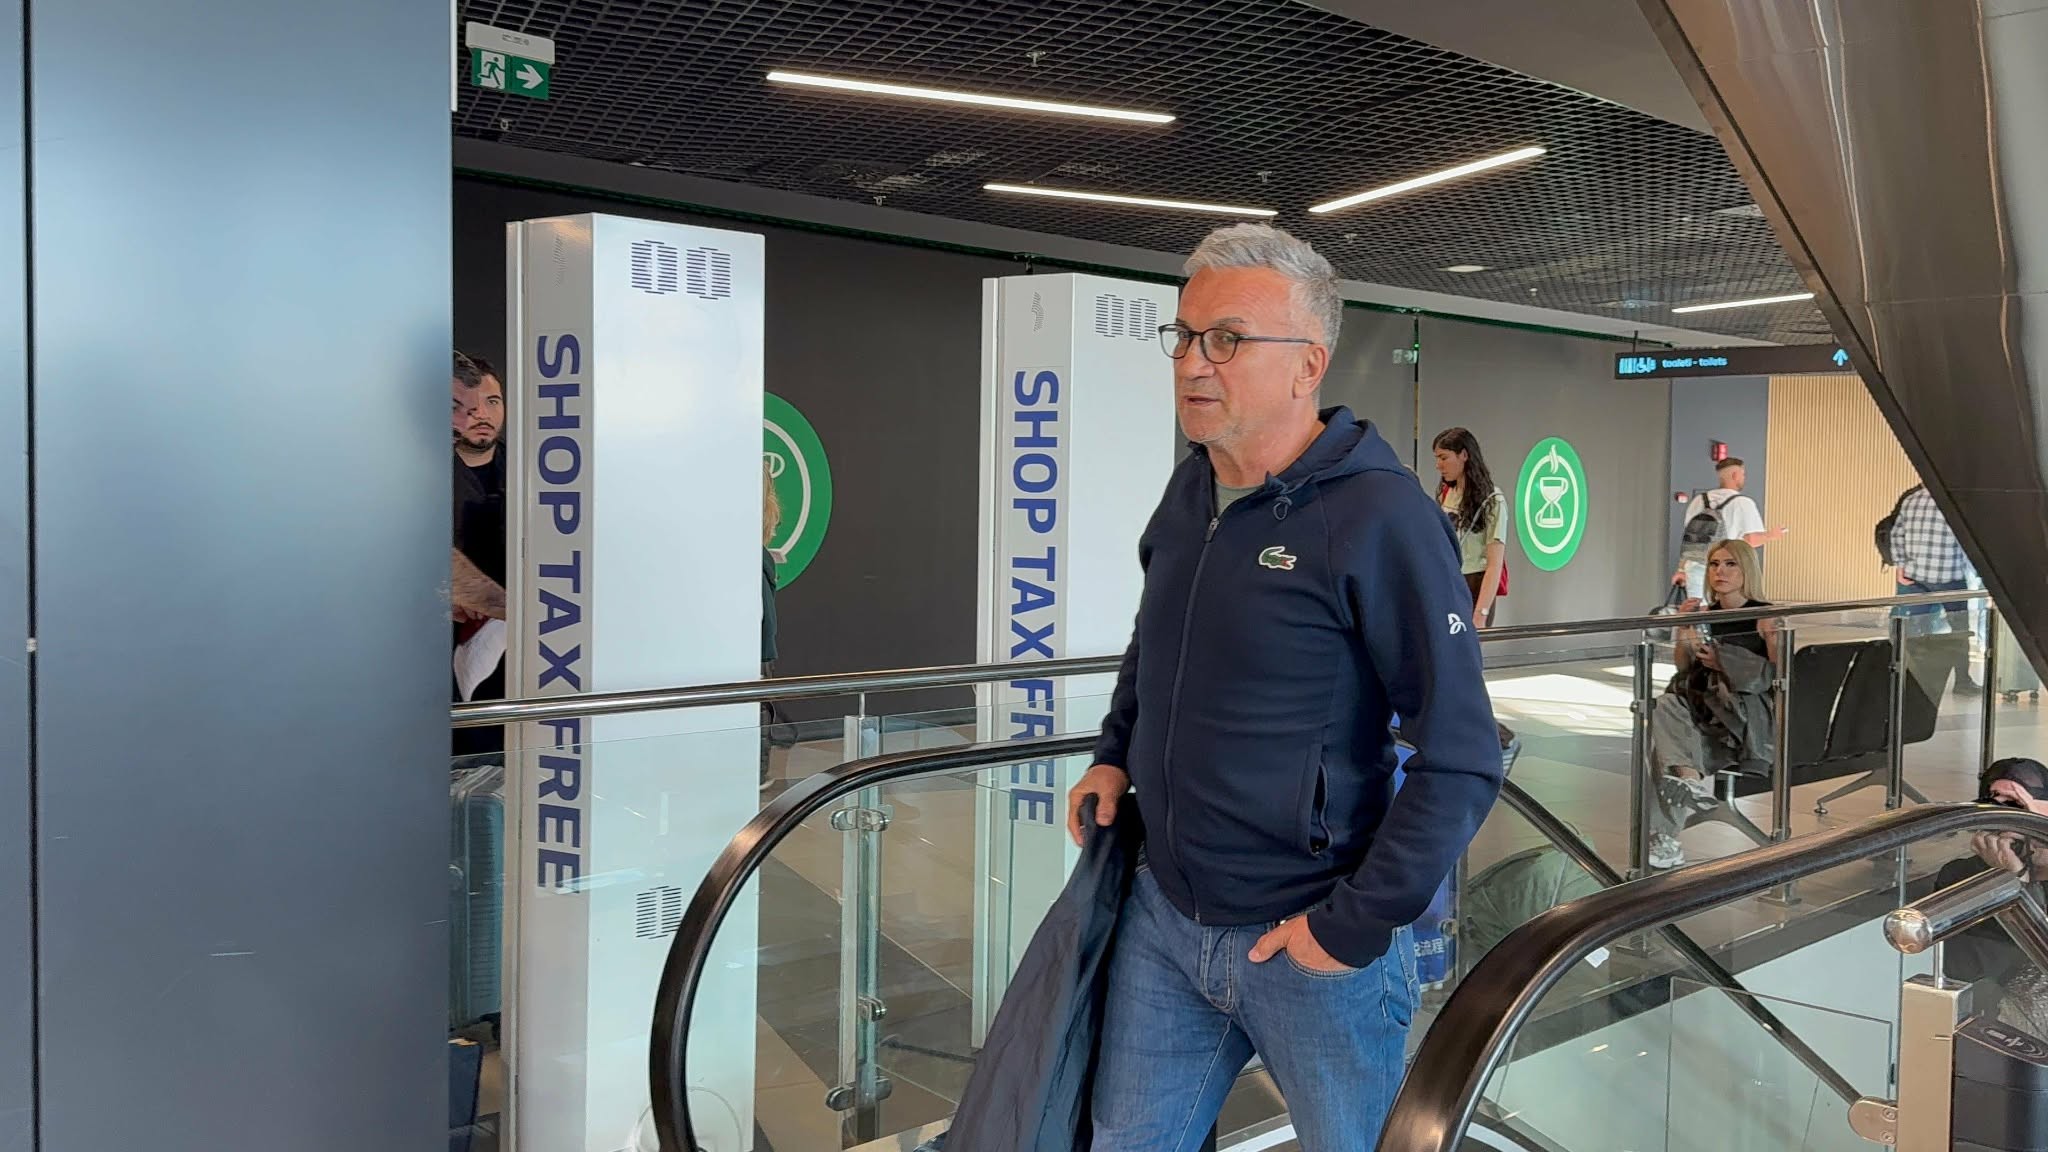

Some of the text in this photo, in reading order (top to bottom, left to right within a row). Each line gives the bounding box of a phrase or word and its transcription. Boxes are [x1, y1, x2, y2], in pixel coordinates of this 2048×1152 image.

[1699, 356, 1727, 367] toilets
[537, 334, 581, 894] SHOP TAX FREE
[1009, 370, 1060, 825] SHOP TAX FREE
